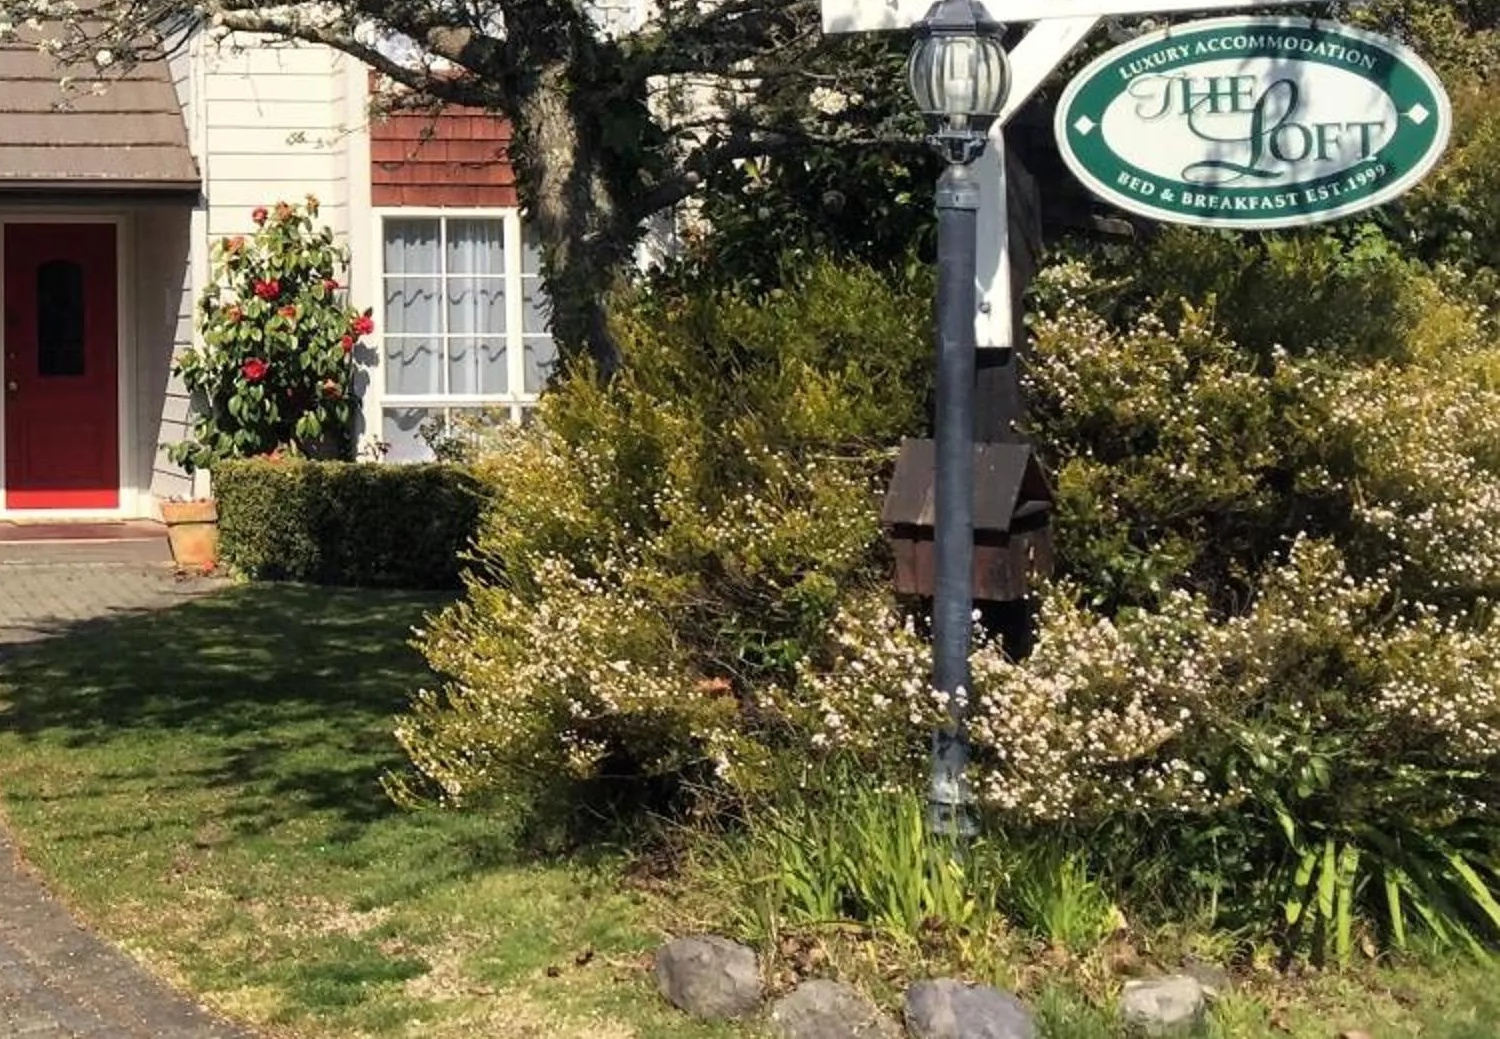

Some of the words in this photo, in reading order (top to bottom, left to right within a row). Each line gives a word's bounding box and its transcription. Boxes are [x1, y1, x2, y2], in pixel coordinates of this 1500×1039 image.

[1118, 44, 1190, 80] LUXURY
[1195, 35, 1378, 70] ACCOMMODATION
[1127, 72, 1257, 121] THE
[1117, 172, 1155, 196] BED
[1159, 187, 1175, 203] &
[1181, 191, 1300, 211] BREAKFAST
